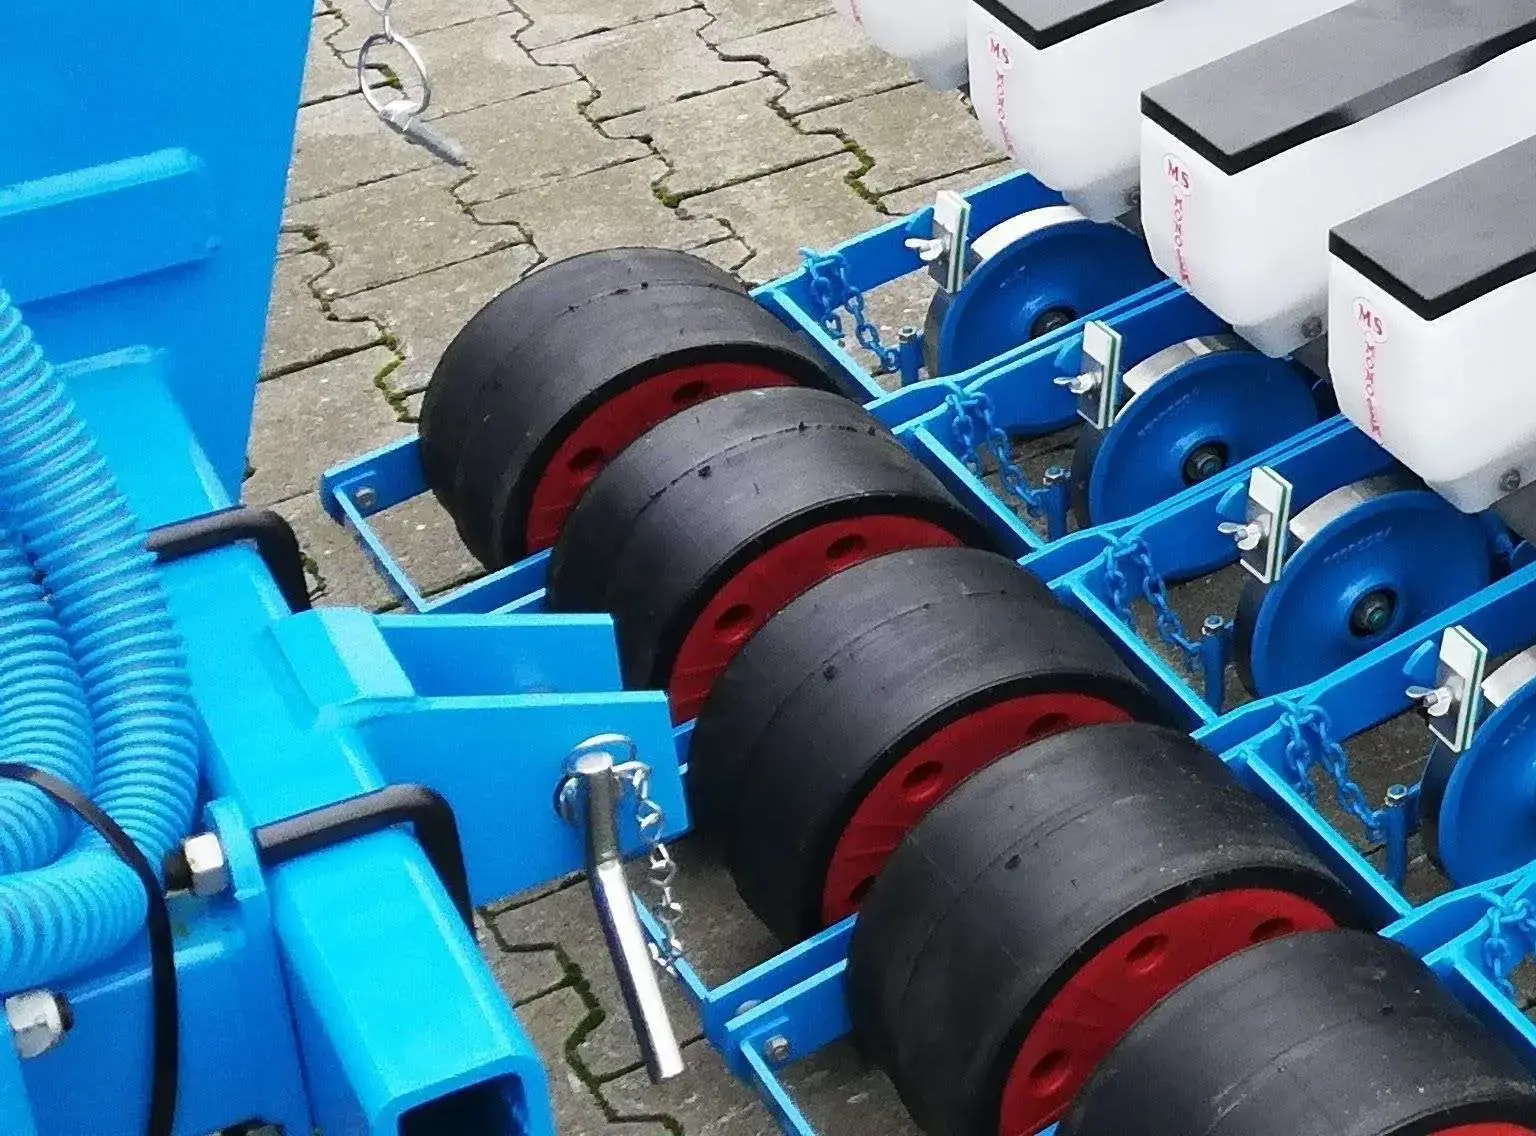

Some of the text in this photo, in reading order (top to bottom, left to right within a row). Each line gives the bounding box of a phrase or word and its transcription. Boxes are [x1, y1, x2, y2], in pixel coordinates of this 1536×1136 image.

[989, 36, 1010, 65] MS
[1167, 157, 1190, 190] MS
[1357, 302, 1383, 336] MS
